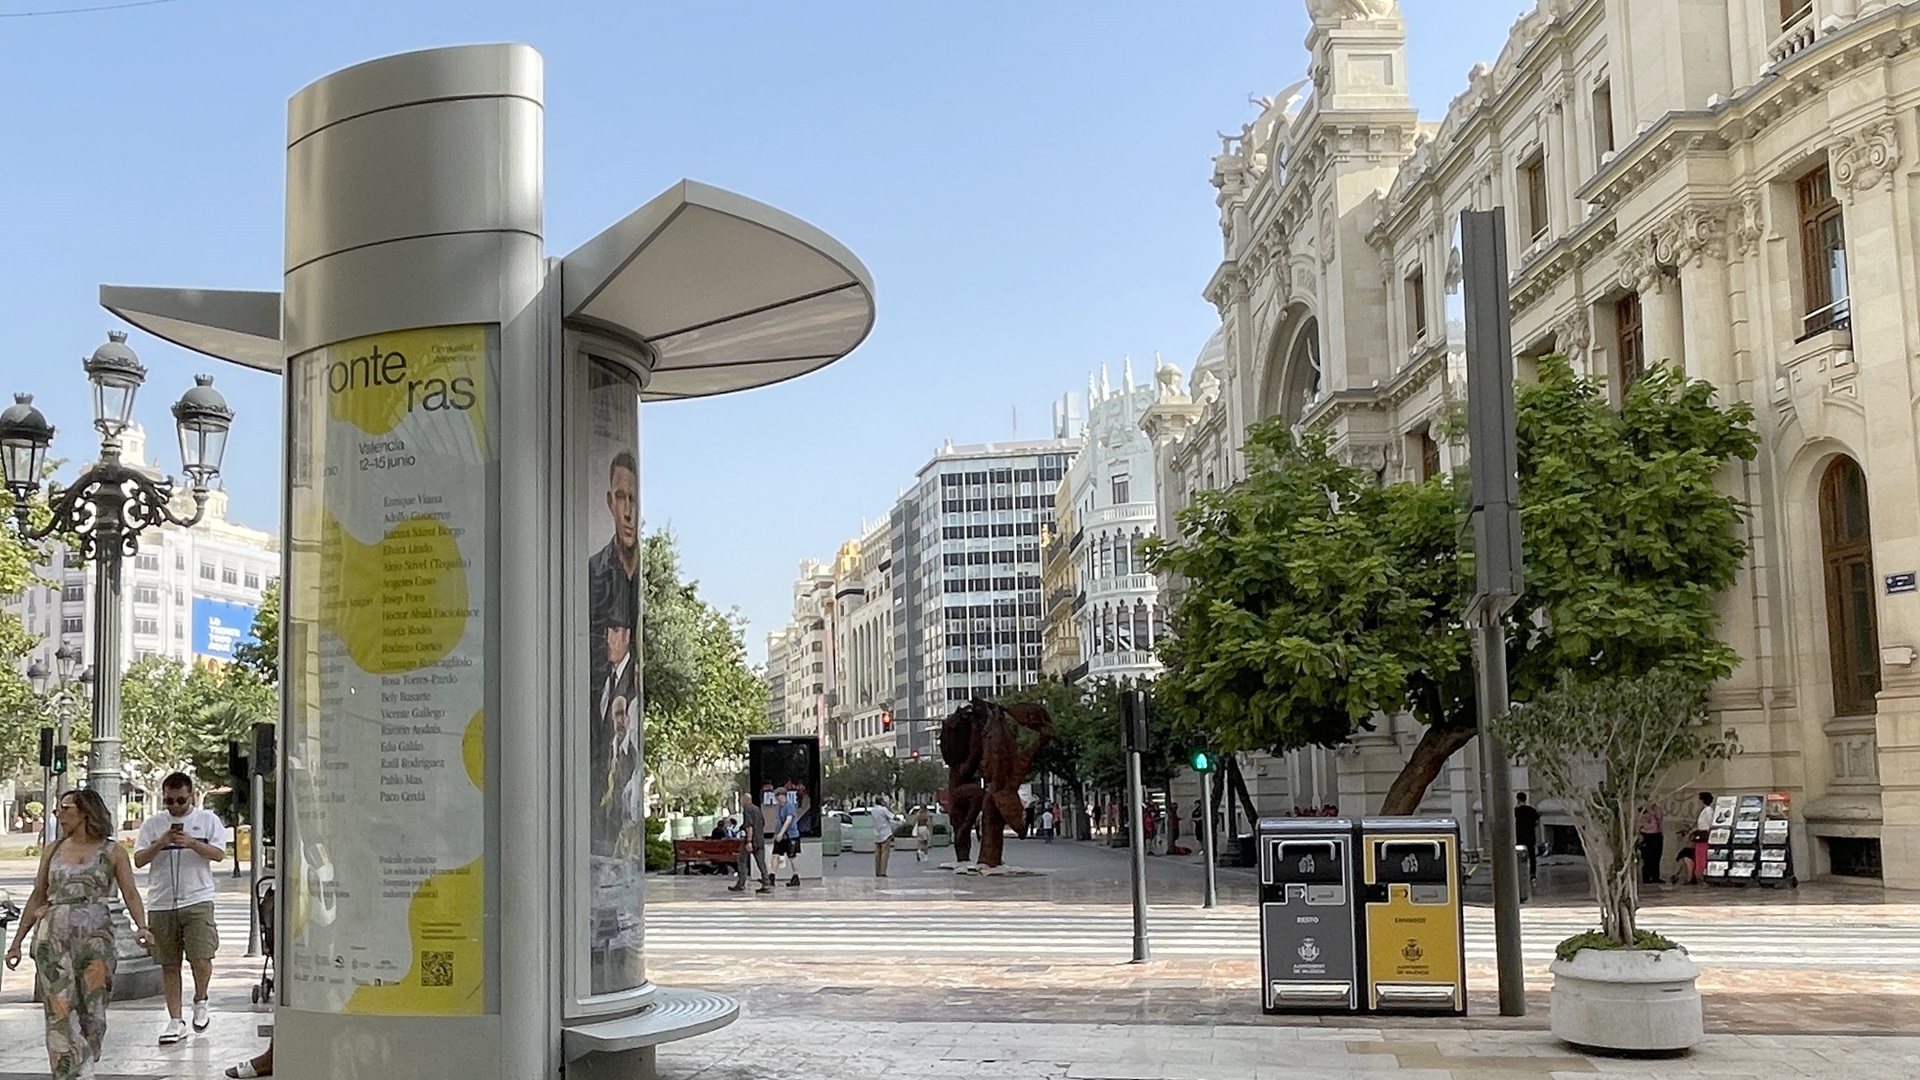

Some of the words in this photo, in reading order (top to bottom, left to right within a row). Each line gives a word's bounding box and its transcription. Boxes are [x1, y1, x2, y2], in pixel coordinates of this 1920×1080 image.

[407, 375, 476, 413] ras
[386, 453, 416, 470] junio
[208, 616, 222, 627] LO
[208, 625, 241, 638] TIENES
[208, 633, 232, 645] TODO
[380, 676, 400, 687] Rosa
[402, 672, 458, 686] Torres-Pardo
[380, 708, 410, 719] Vicente
[411, 705, 446, 721] Gallego
[380, 740, 397, 753] Edu
[398, 740, 424, 752] Galán
[380, 773, 403, 786] Pablo
[404, 774, 423, 785] Mas
[379, 790, 400, 802] Paco
